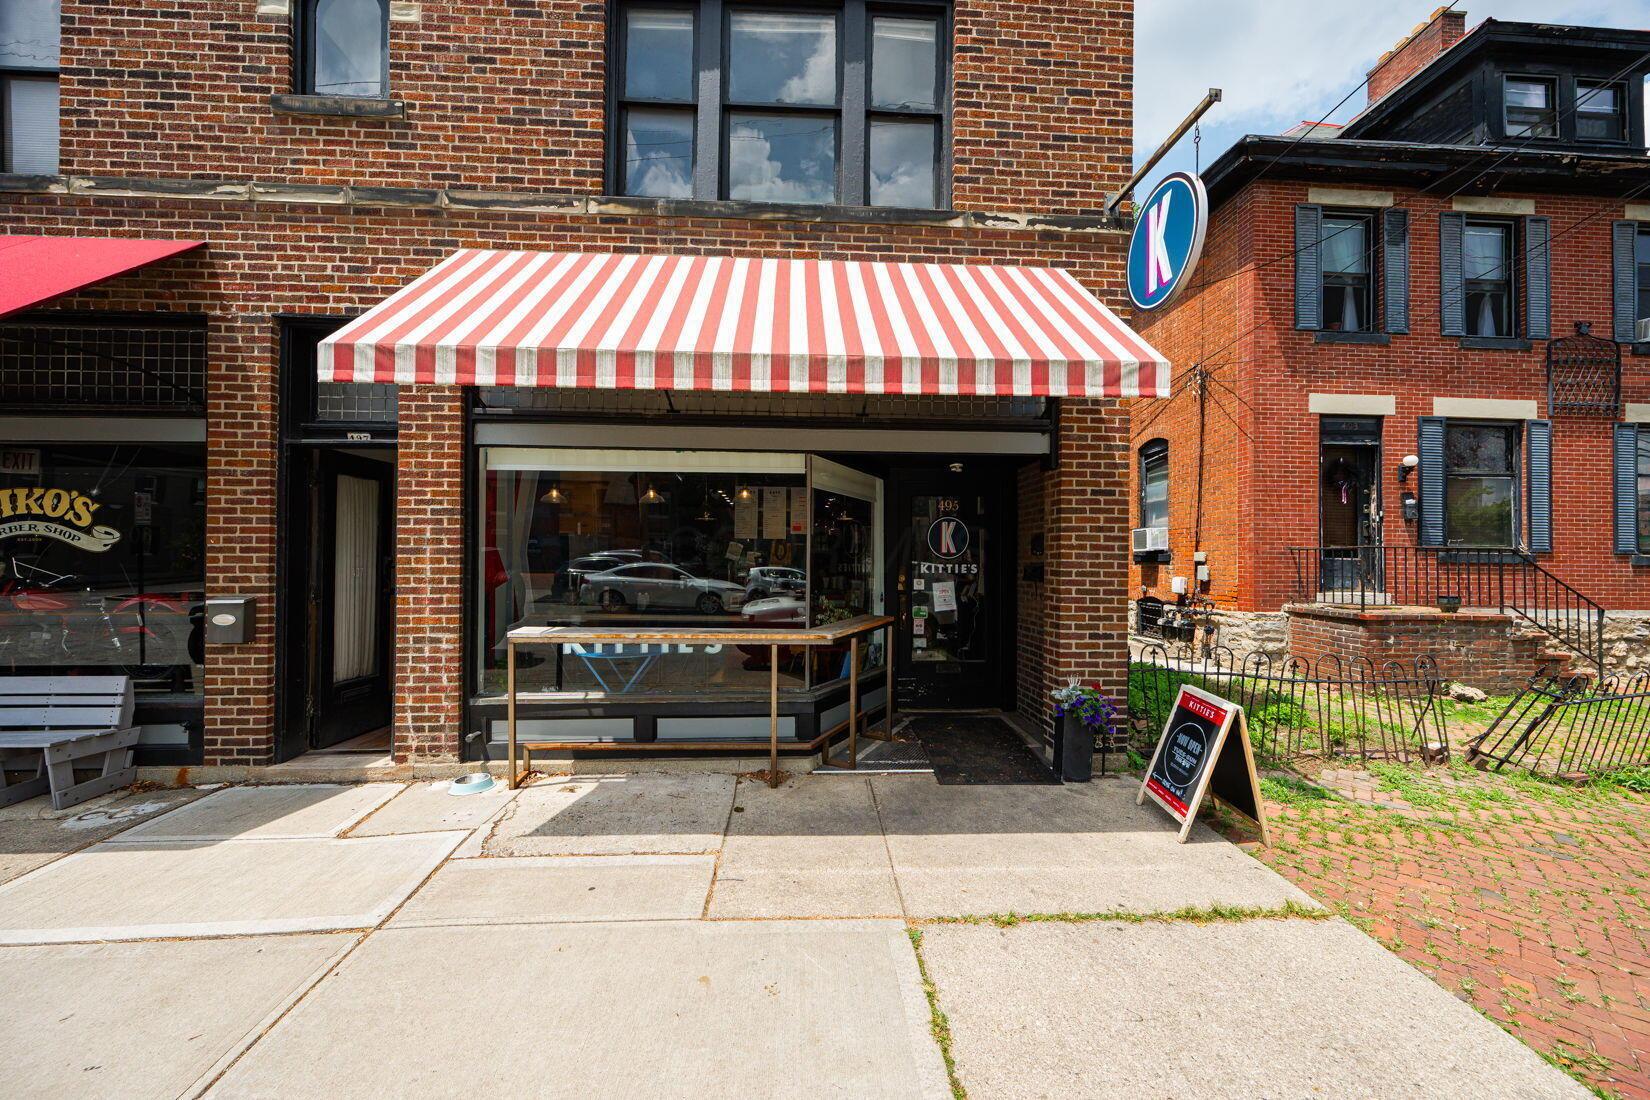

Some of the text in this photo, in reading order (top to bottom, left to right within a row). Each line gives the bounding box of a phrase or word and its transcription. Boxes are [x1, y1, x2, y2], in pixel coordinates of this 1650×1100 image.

[1146, 188, 1173, 298] K
[3, 452, 35, 470] EXIT
[938, 500, 959, 511] 495
[43, 523, 82, 543] SHOP
[941, 522, 957, 554] K
[920, 563, 978, 574] KITTIE'S
